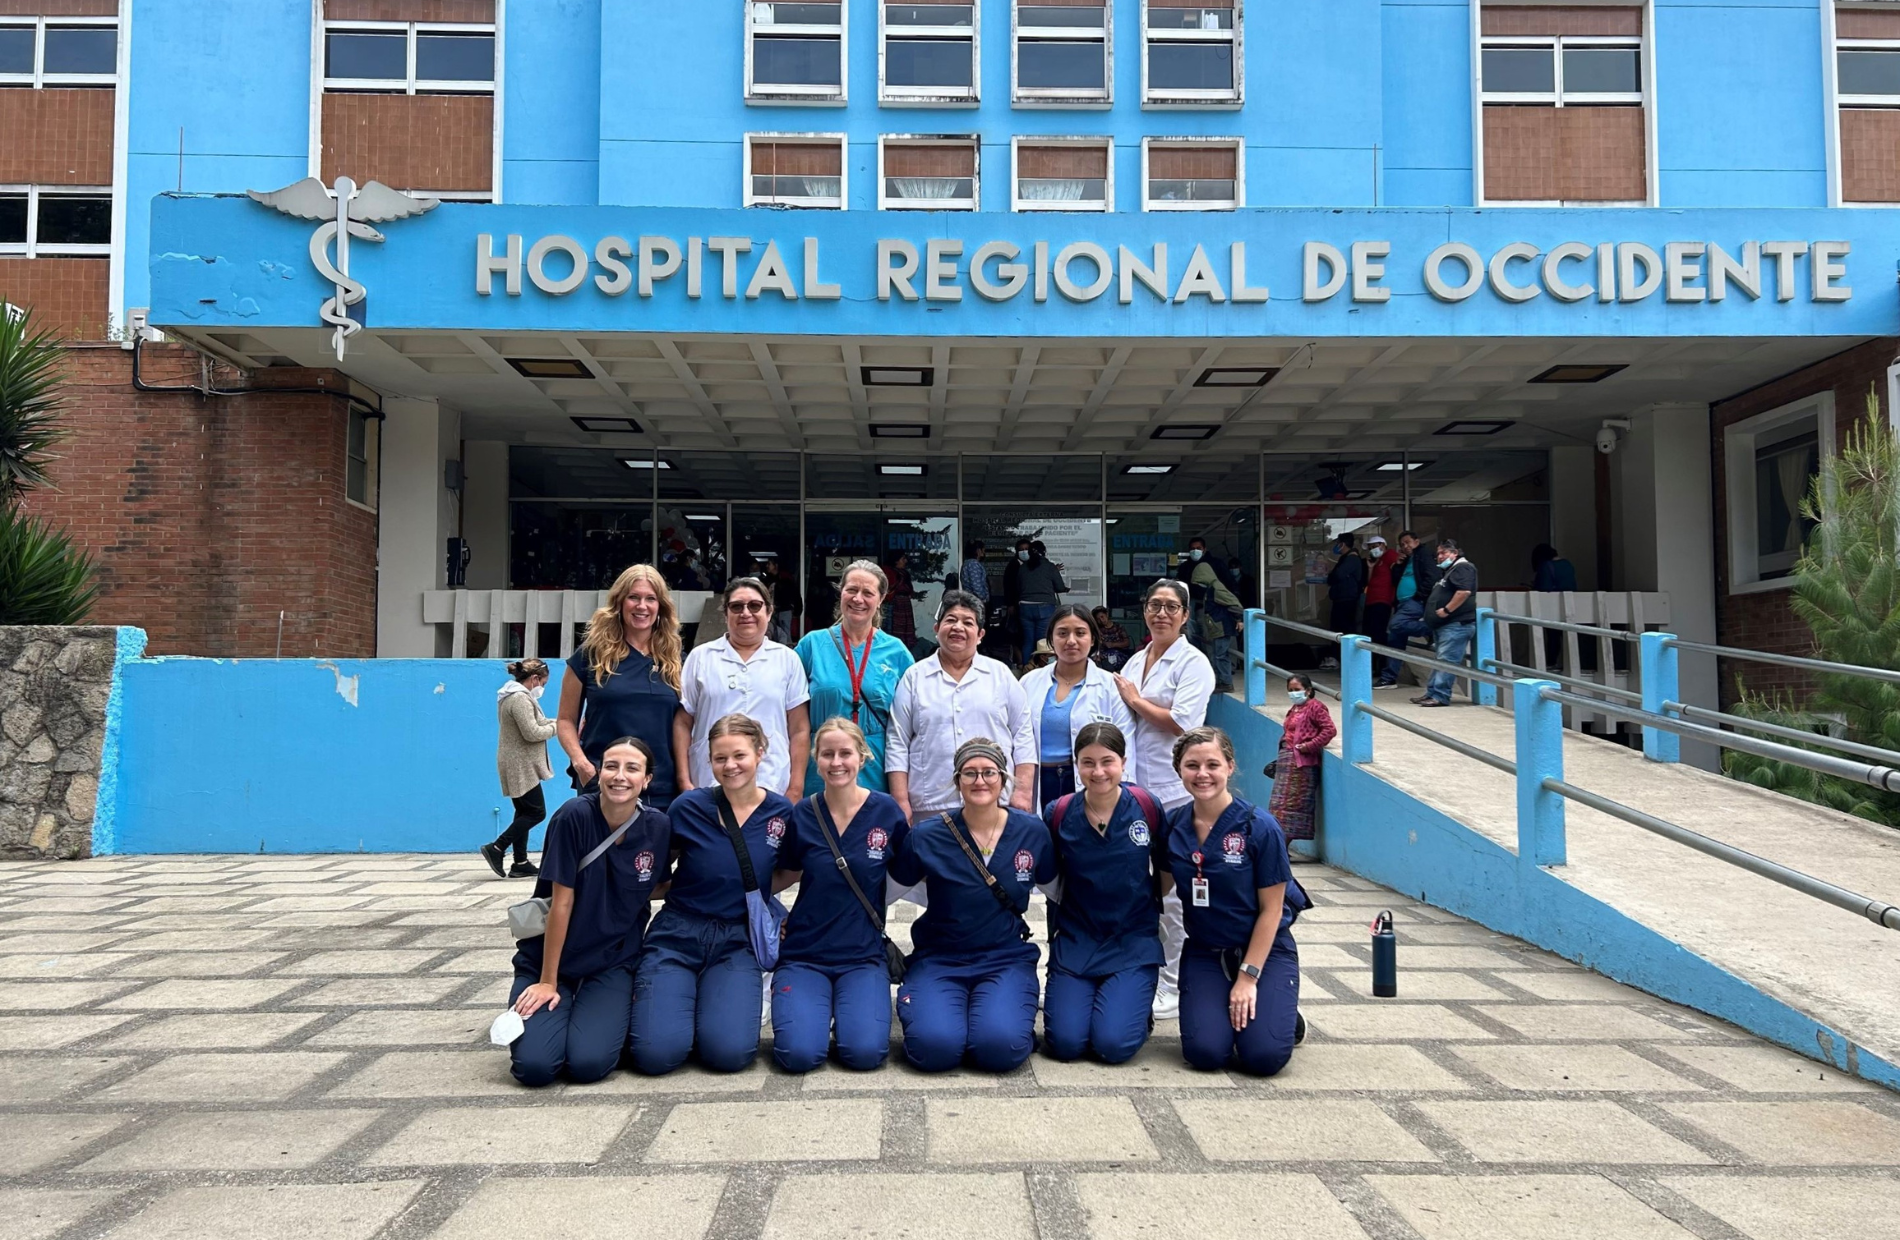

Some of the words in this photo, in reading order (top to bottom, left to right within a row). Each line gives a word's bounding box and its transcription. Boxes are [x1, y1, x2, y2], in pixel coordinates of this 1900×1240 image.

[475, 233, 842, 299] HOSPITAL
[876, 239, 1269, 304] REGIONAL
[1302, 240, 1391, 303] DE
[1423, 240, 1853, 303] OCCIDENTE
[888, 532, 952, 550] ENTRADA
[1113, 534, 1175, 549] ENTRADA
